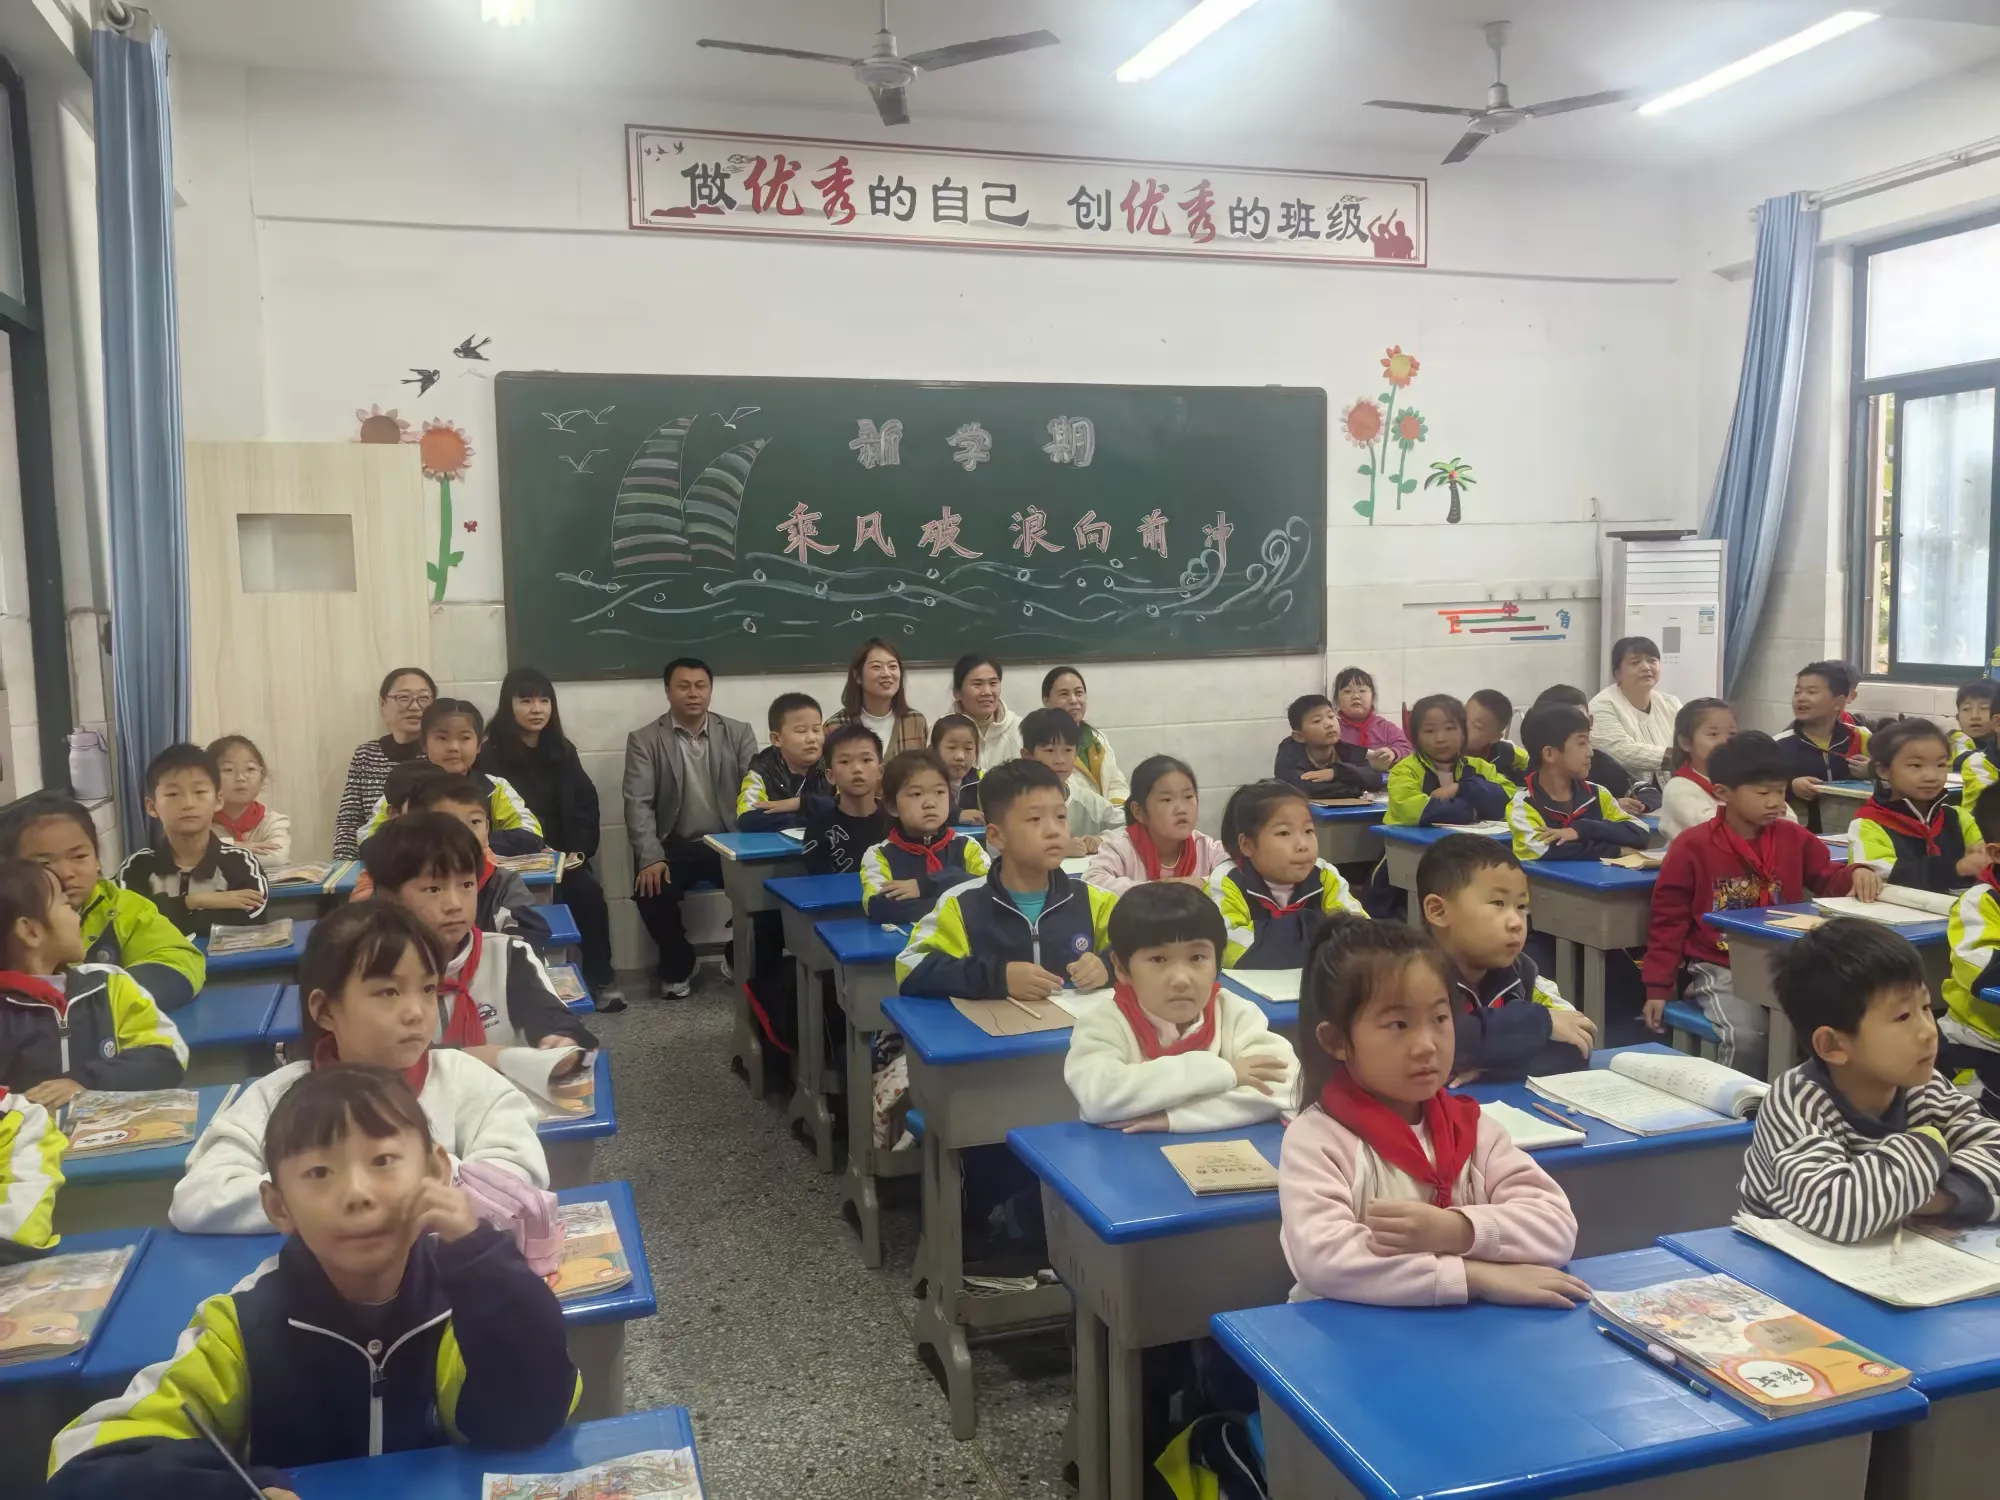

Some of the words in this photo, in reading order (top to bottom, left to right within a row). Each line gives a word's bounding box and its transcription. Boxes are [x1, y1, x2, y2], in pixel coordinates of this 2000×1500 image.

[680, 154, 1029, 226] 做优秀的自己
[1067, 178, 1370, 244] 创优秀的班级
[848, 416, 1096, 471] 新学期
[776, 501, 1235, 568] 乘风破浪向前冲
